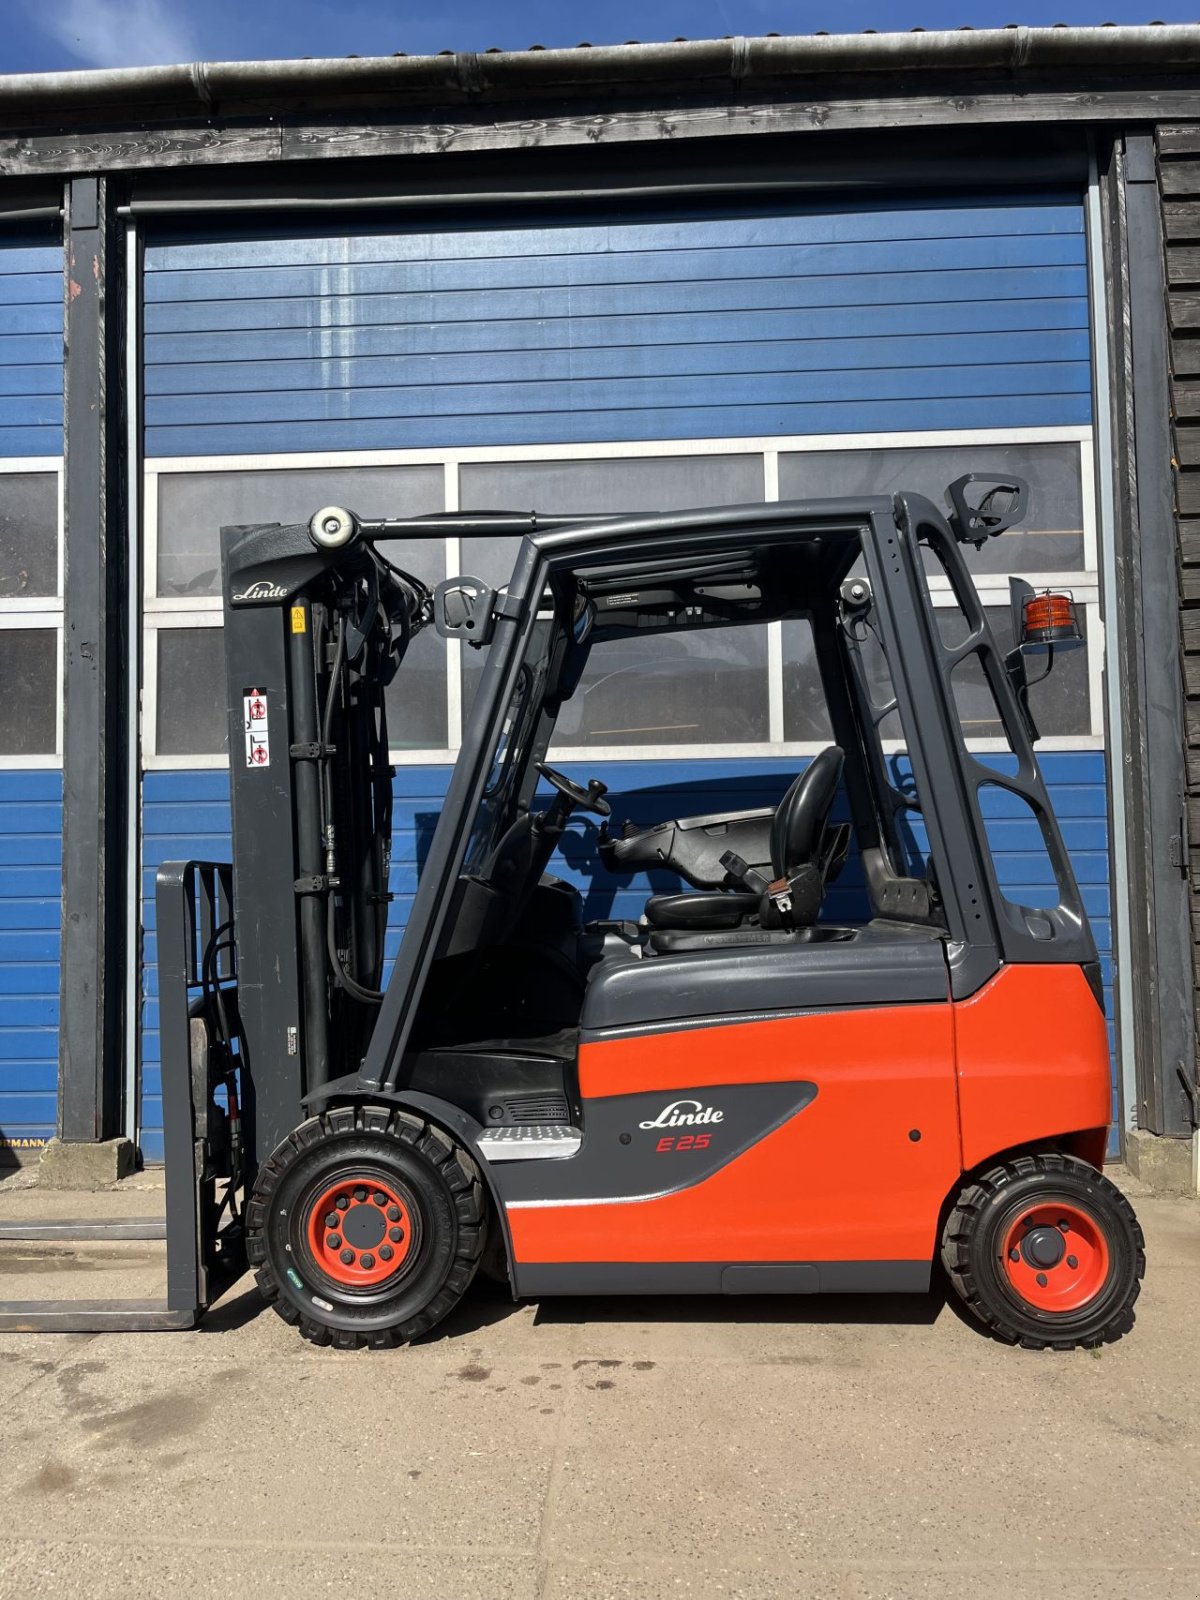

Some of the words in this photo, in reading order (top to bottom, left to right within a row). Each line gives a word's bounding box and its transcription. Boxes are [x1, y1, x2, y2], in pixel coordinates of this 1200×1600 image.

[232, 581, 288, 600] Linde
[638, 1100, 724, 1129] Linde
[0, 1138, 45, 1148] RMANN
